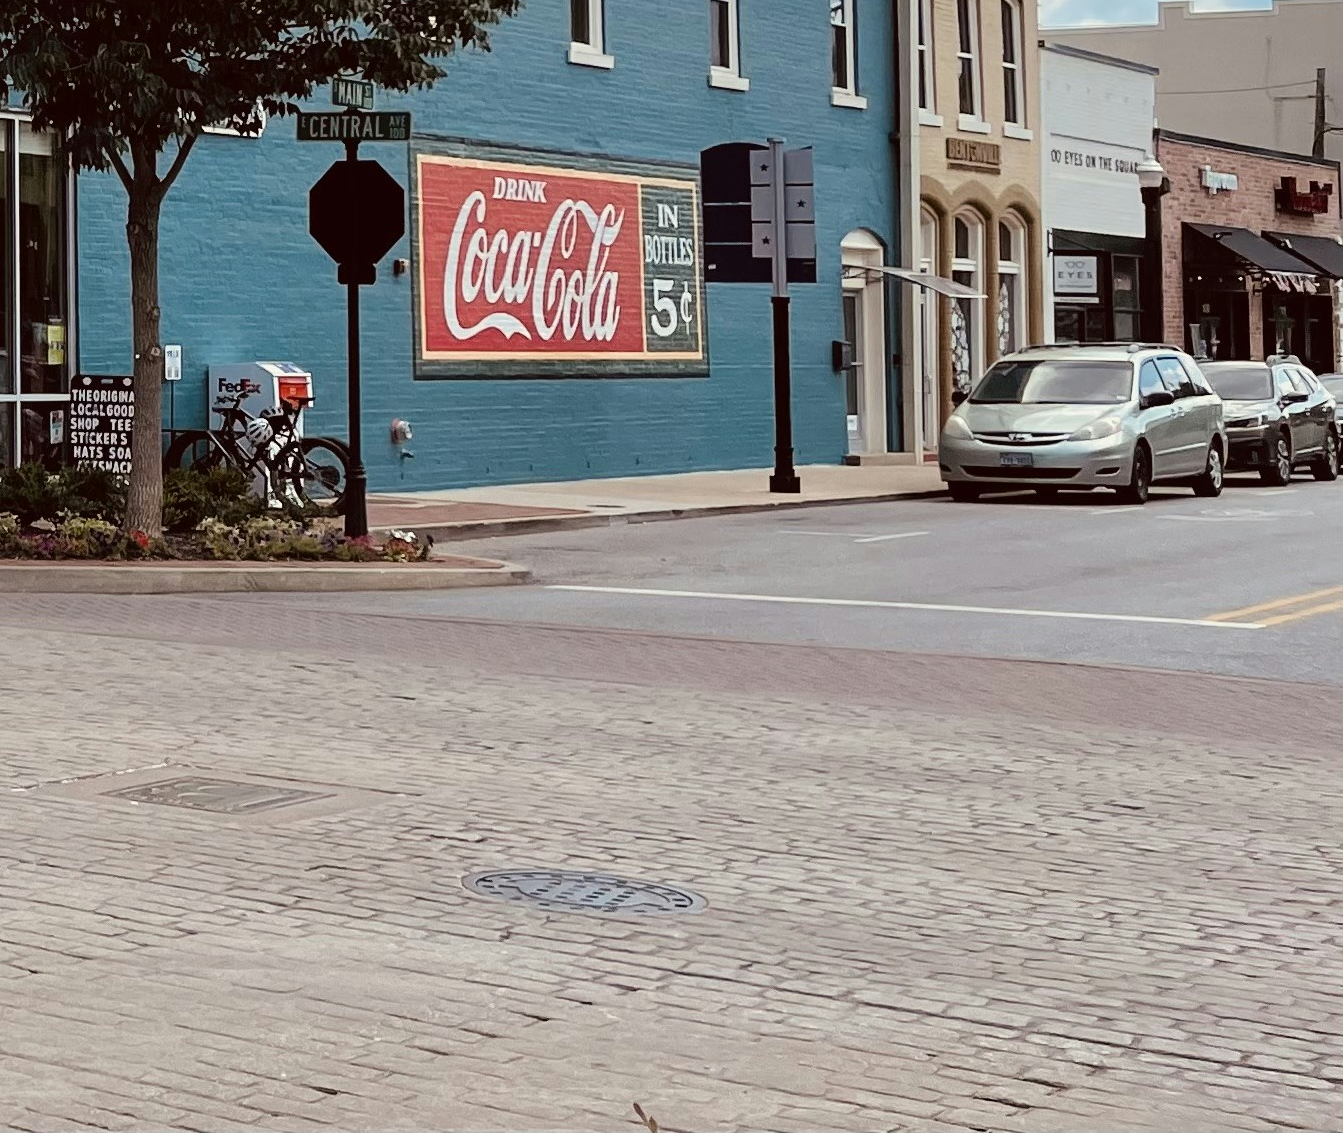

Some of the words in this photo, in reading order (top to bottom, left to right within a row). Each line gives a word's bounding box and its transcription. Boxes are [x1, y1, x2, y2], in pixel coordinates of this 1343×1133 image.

[338, 81, 363, 106] MAIN
[301, 116, 306, 128] E
[309, 115, 384, 138] CENTRAL
[389, 115, 405, 127] AVE
[1064, 151, 1083, 166] EYES
[1086, 155, 1096, 168] ON
[1099, 156, 1112, 171] THE
[1115, 159, 1138, 173] SQUAR
[492, 176, 547, 204] DRINK
[656, 203, 679, 229] IN
[644, 234, 694, 266] BOTTLES
[443, 190, 625, 341] Coca-Cola
[1058, 271, 1093, 279] EYES
[218, 377, 262, 394] FedEx
[70, 417, 100, 430] SHOP
[110, 418, 135, 431] TEE
[70, 431, 128, 445] STICKERS
[73, 446, 104, 459] HATS
[108, 447, 132, 460] SOA
